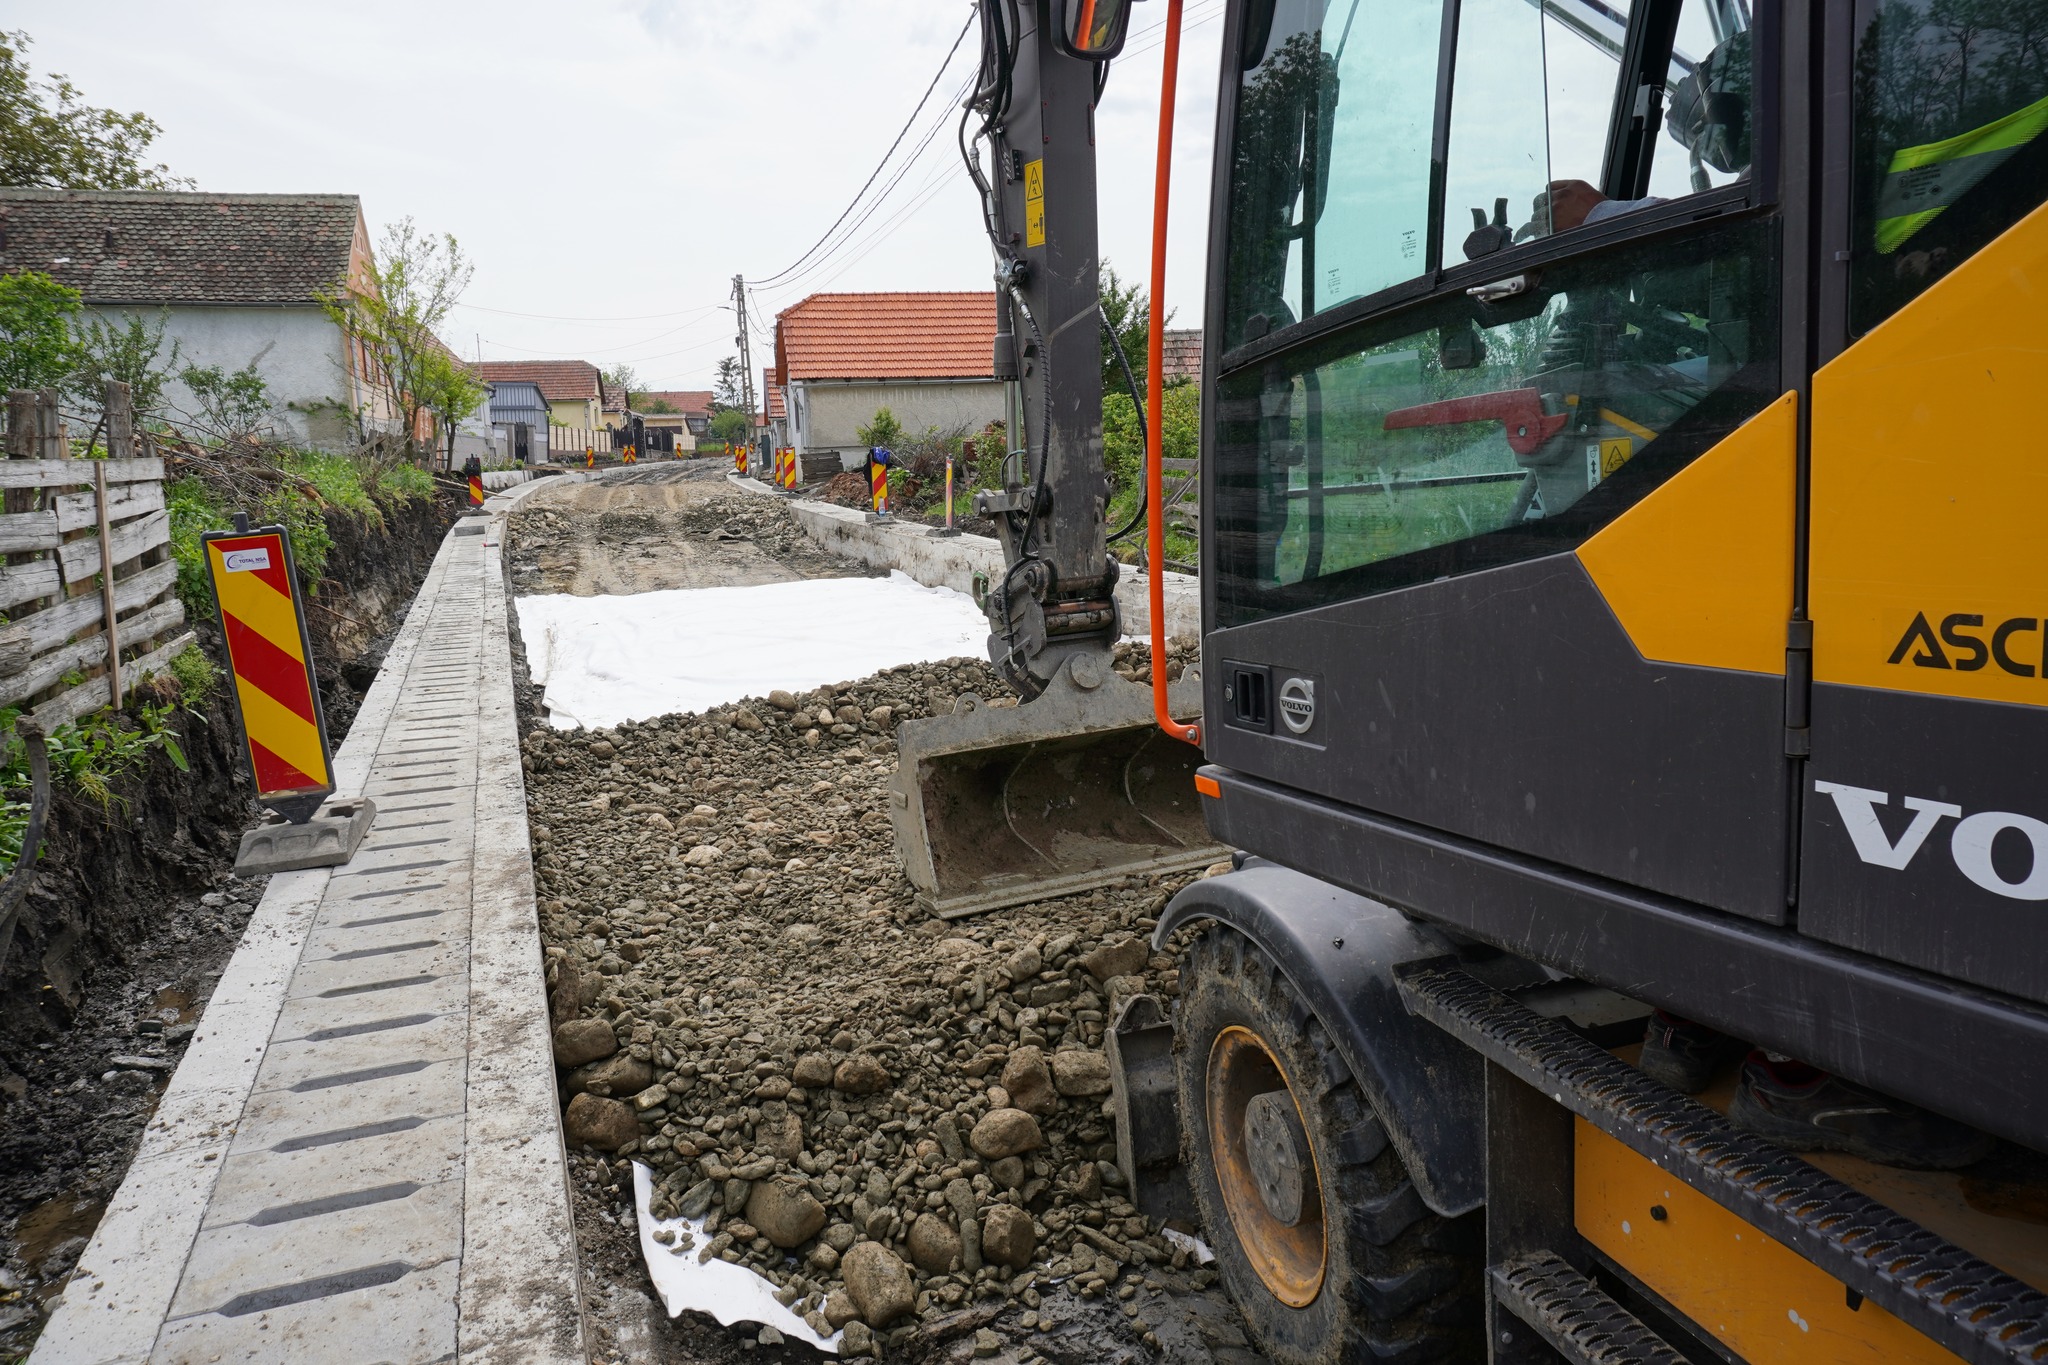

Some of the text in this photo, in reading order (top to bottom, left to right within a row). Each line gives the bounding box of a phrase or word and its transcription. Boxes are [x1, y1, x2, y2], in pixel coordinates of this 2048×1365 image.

[1887, 610, 2048, 680] ASC
[1280, 699, 1313, 713] VOLVO
[1814, 779, 2048, 901] VO
